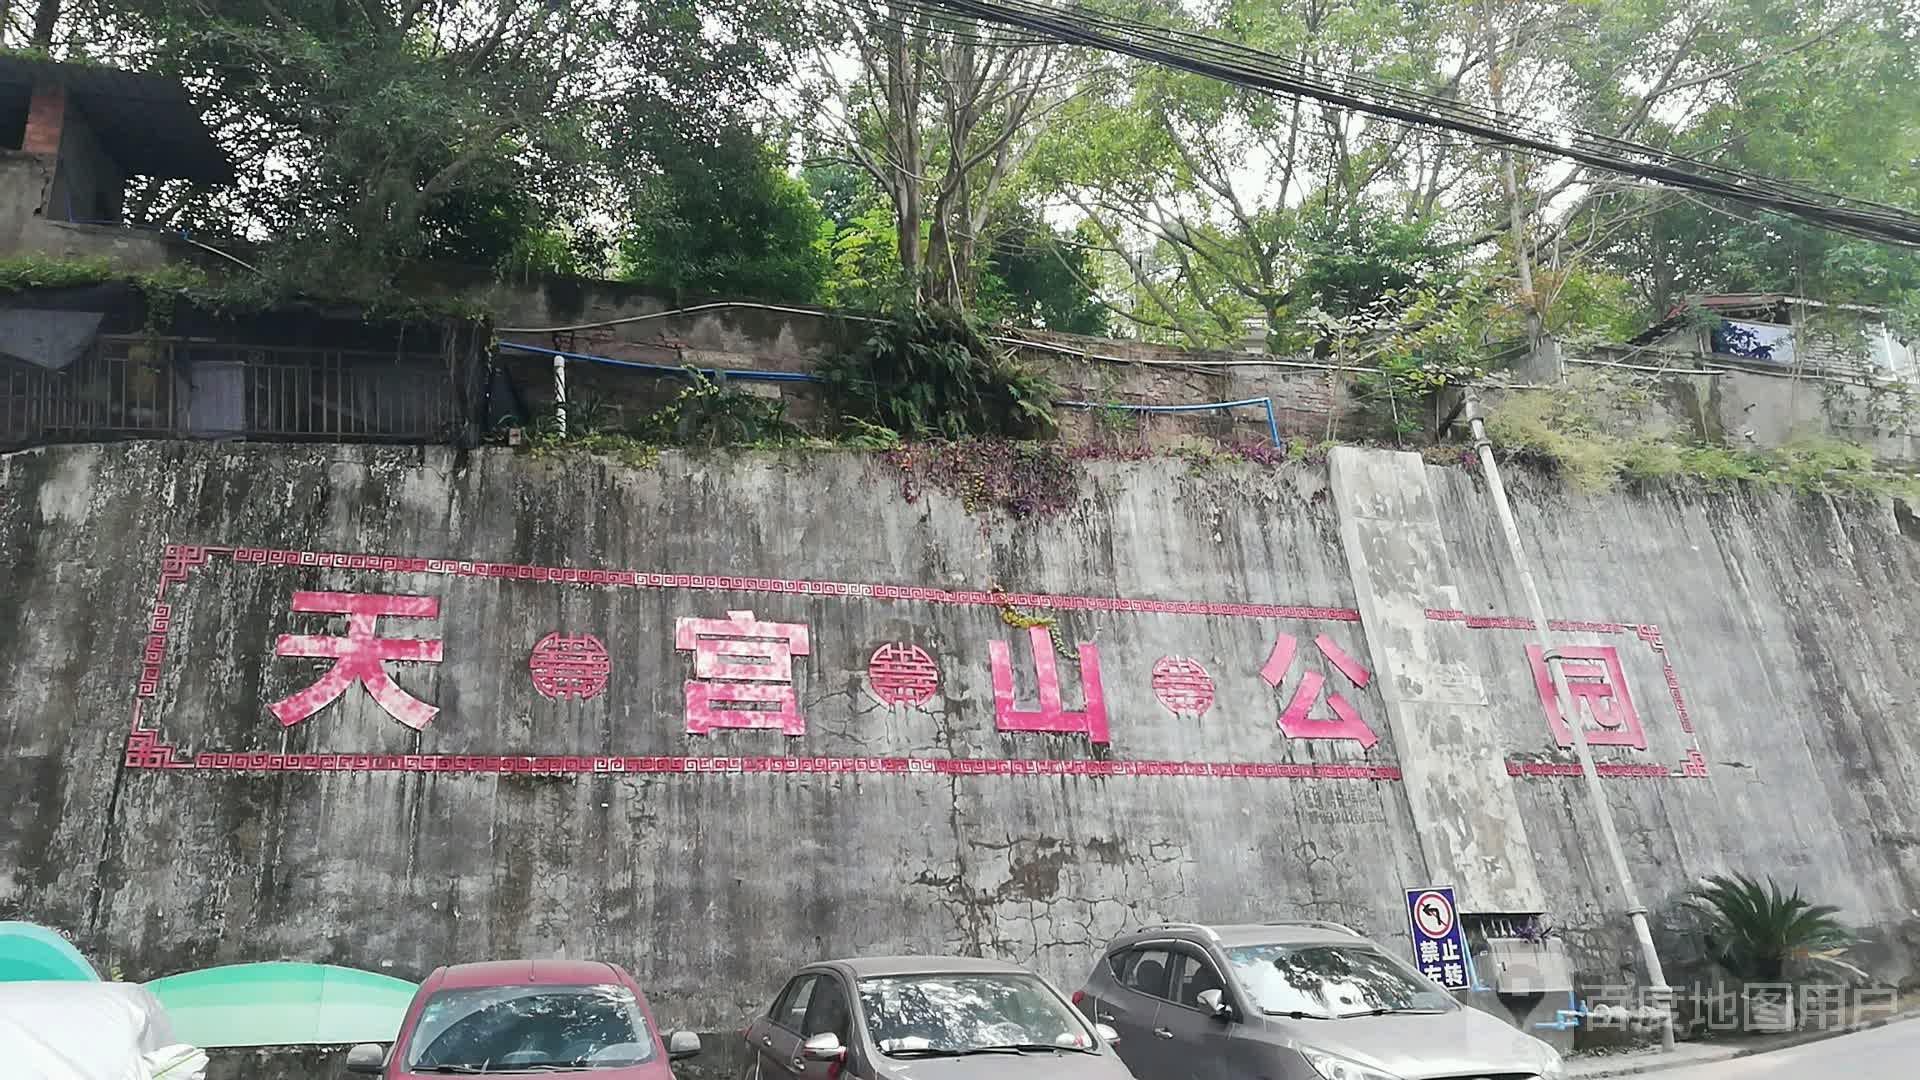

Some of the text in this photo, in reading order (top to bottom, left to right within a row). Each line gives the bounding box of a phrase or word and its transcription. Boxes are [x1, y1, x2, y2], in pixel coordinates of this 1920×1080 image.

[267, 590, 1648, 750] 天宫山公园
[1419, 938, 1460, 963] 禁止
[1423, 962, 1463, 986] 左转
